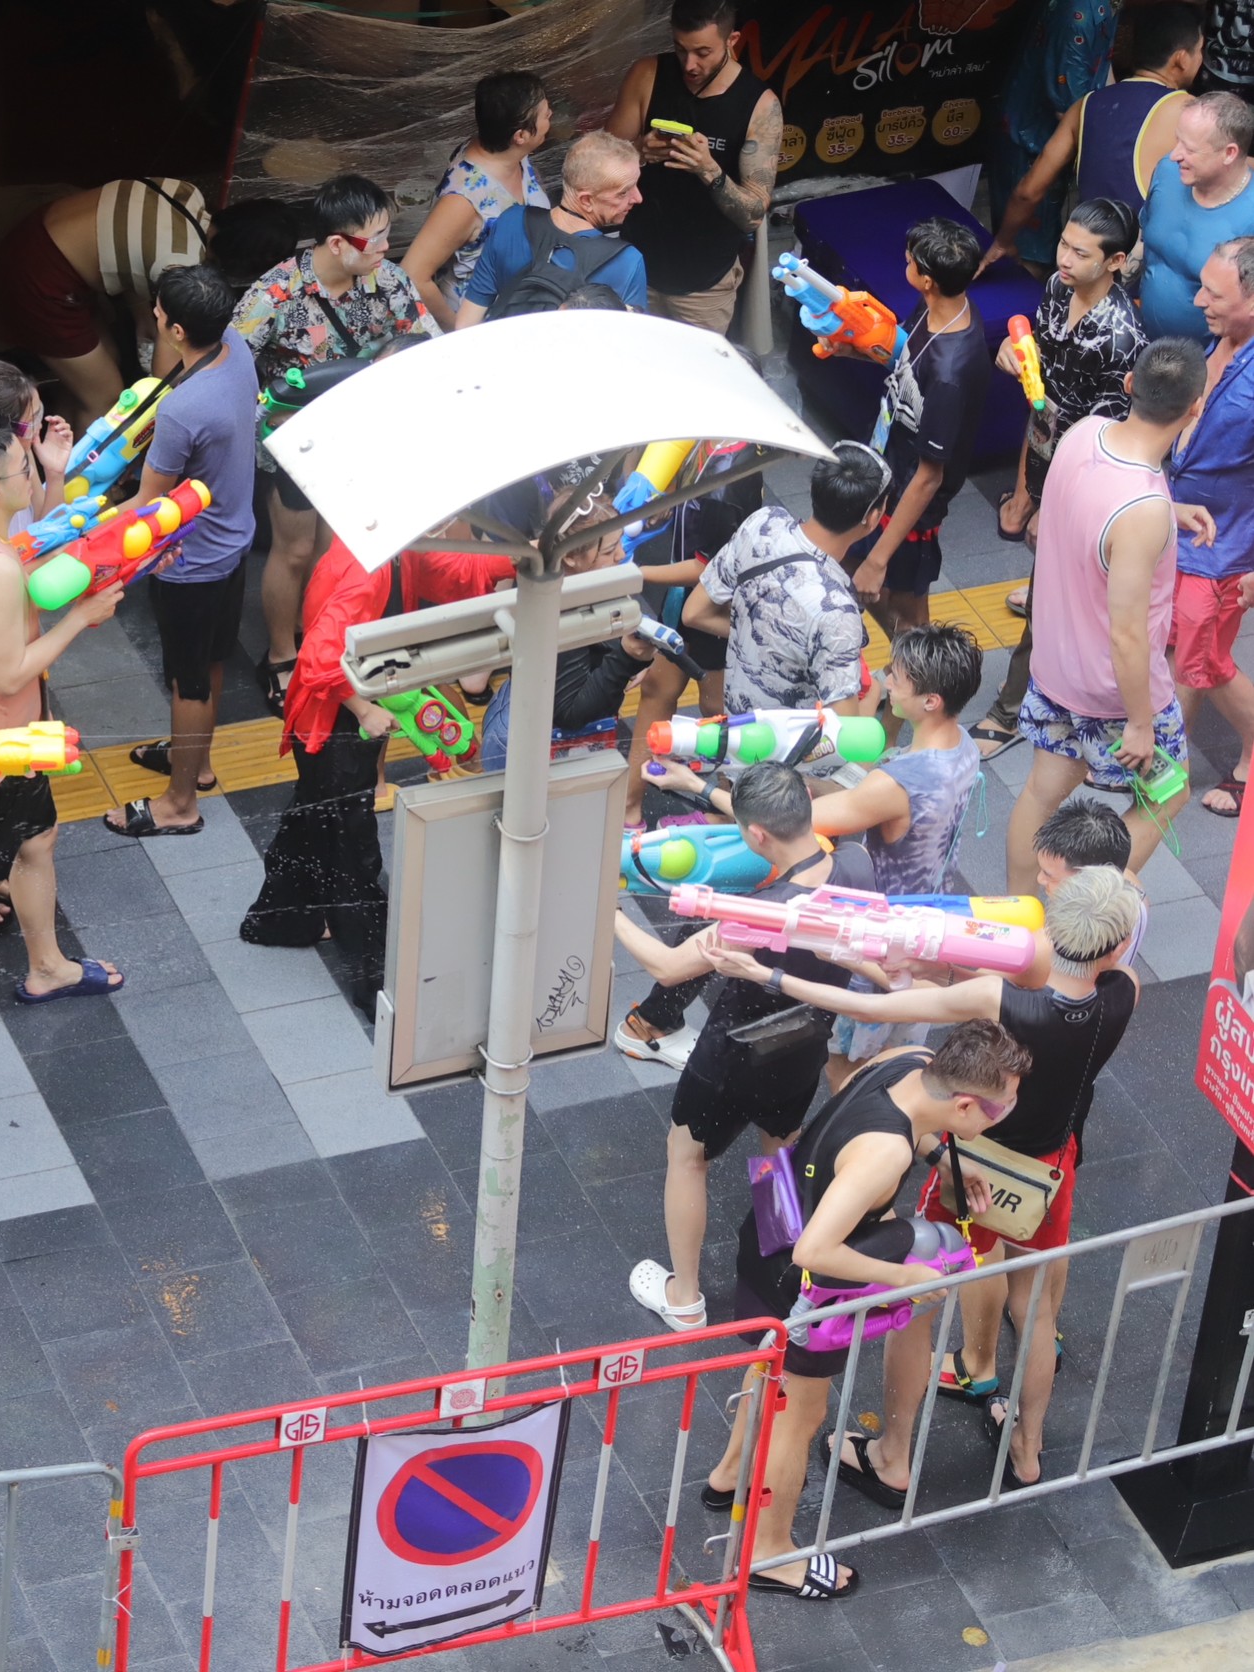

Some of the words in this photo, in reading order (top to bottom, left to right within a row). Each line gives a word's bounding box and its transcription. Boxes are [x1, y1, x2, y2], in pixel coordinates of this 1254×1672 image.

[358, 1558, 535, 1611] ห้ามจอดตลอดแนว
